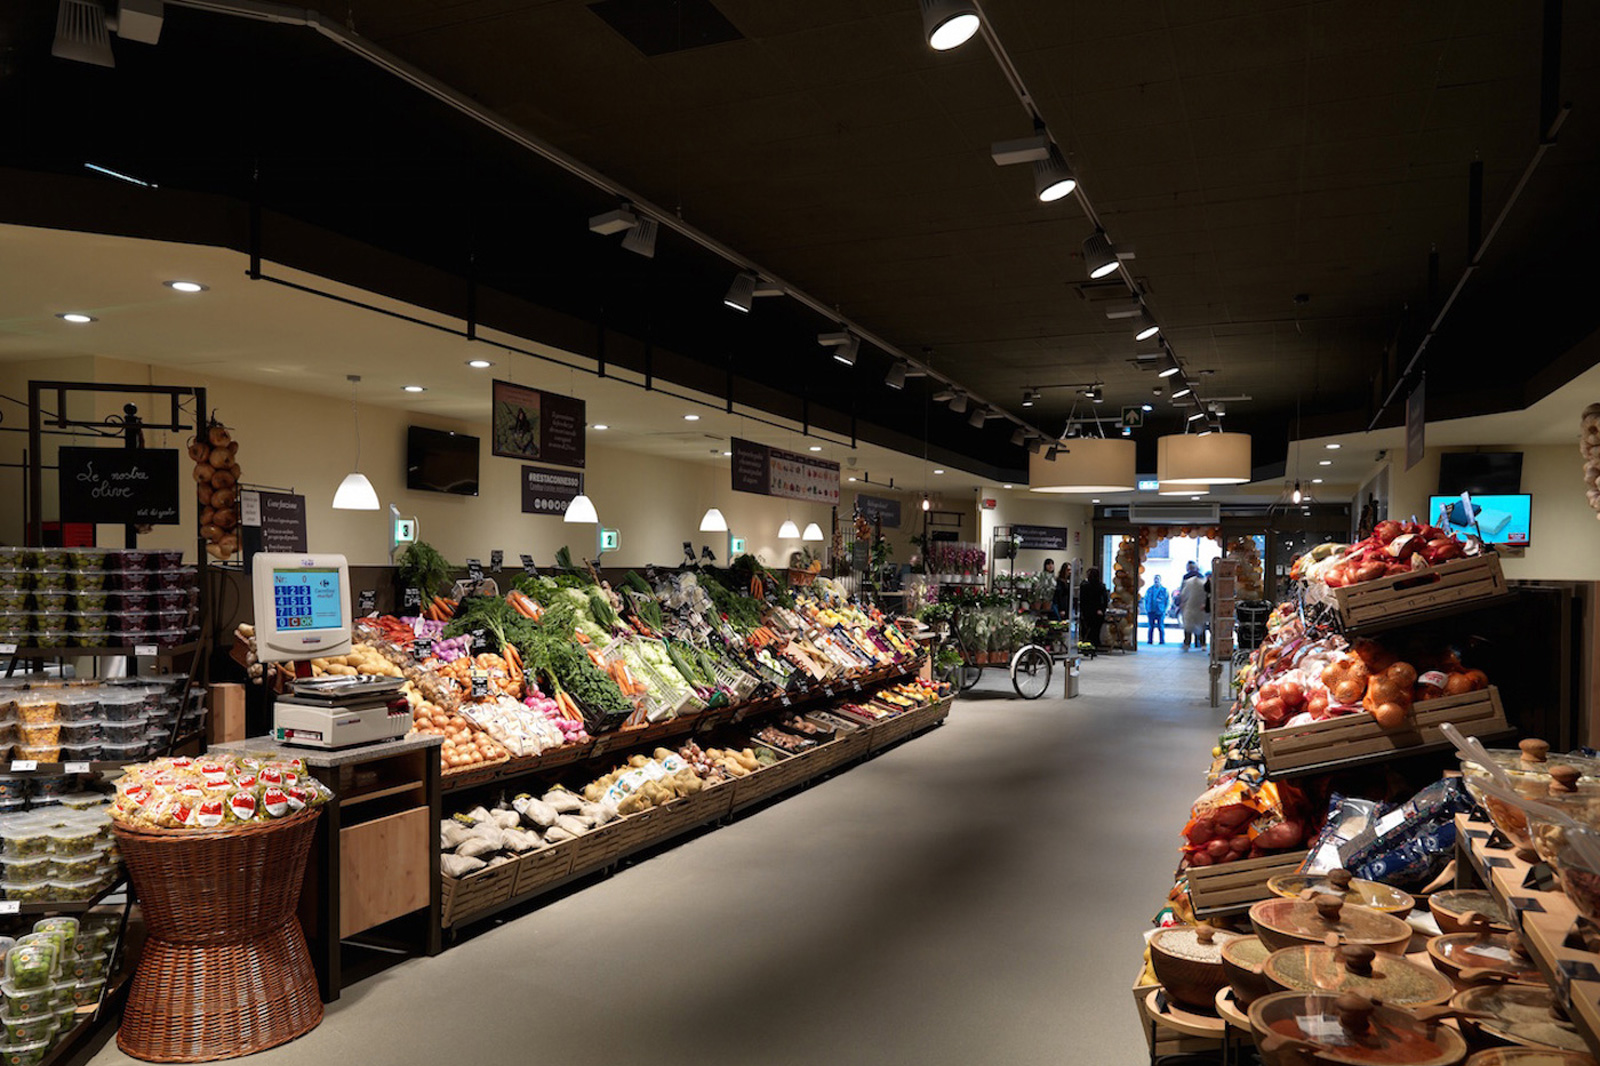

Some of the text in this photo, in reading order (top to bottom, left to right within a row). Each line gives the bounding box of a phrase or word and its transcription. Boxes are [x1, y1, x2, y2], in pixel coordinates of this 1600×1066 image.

[76, 461, 149, 482] Le nostre
[528, 472, 579, 487] #RESTACONNESSO
[91, 480, 134, 498] olive
[403, 524, 409, 537] 3
[608, 535, 612, 546] 2
[302, 575, 307, 584] 0
[278, 586, 308, 594] 1 2 3
[278, 597, 309, 606] 4 5 6
[280, 608, 285, 616] 7
[292, 608, 298, 616] 8
[304, 607, 310, 616] 9
[280, 617, 312, 626] 0 C OK
